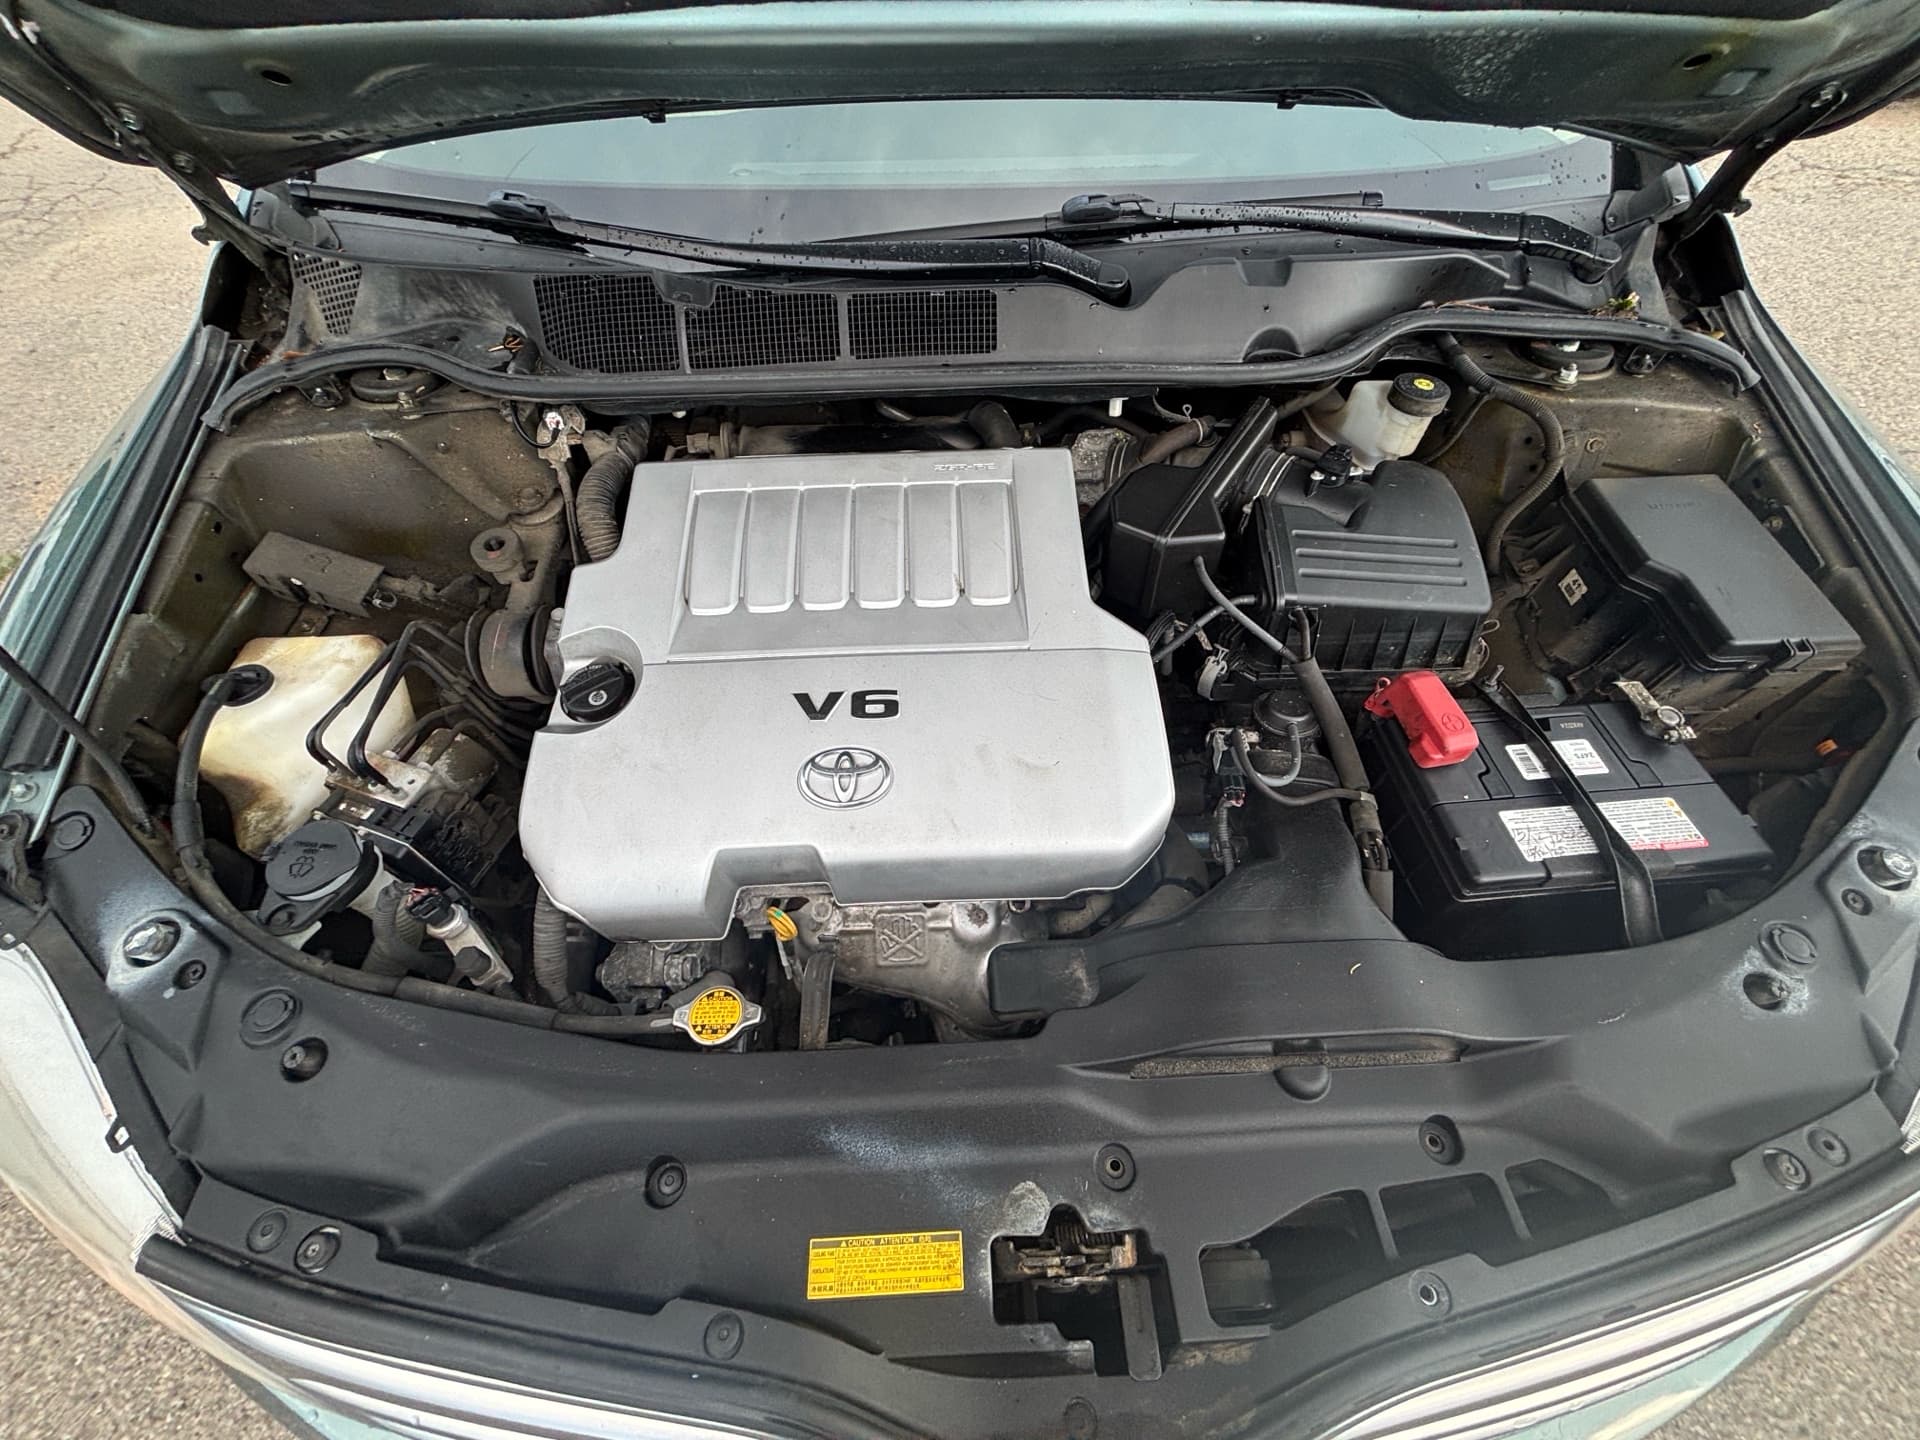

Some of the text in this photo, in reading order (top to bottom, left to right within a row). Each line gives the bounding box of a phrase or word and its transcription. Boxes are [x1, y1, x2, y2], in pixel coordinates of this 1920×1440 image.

[792, 689, 900, 721] V6
[847, 1239, 876, 1247] CAUTION
[879, 1236, 914, 1246] ATTENTION
